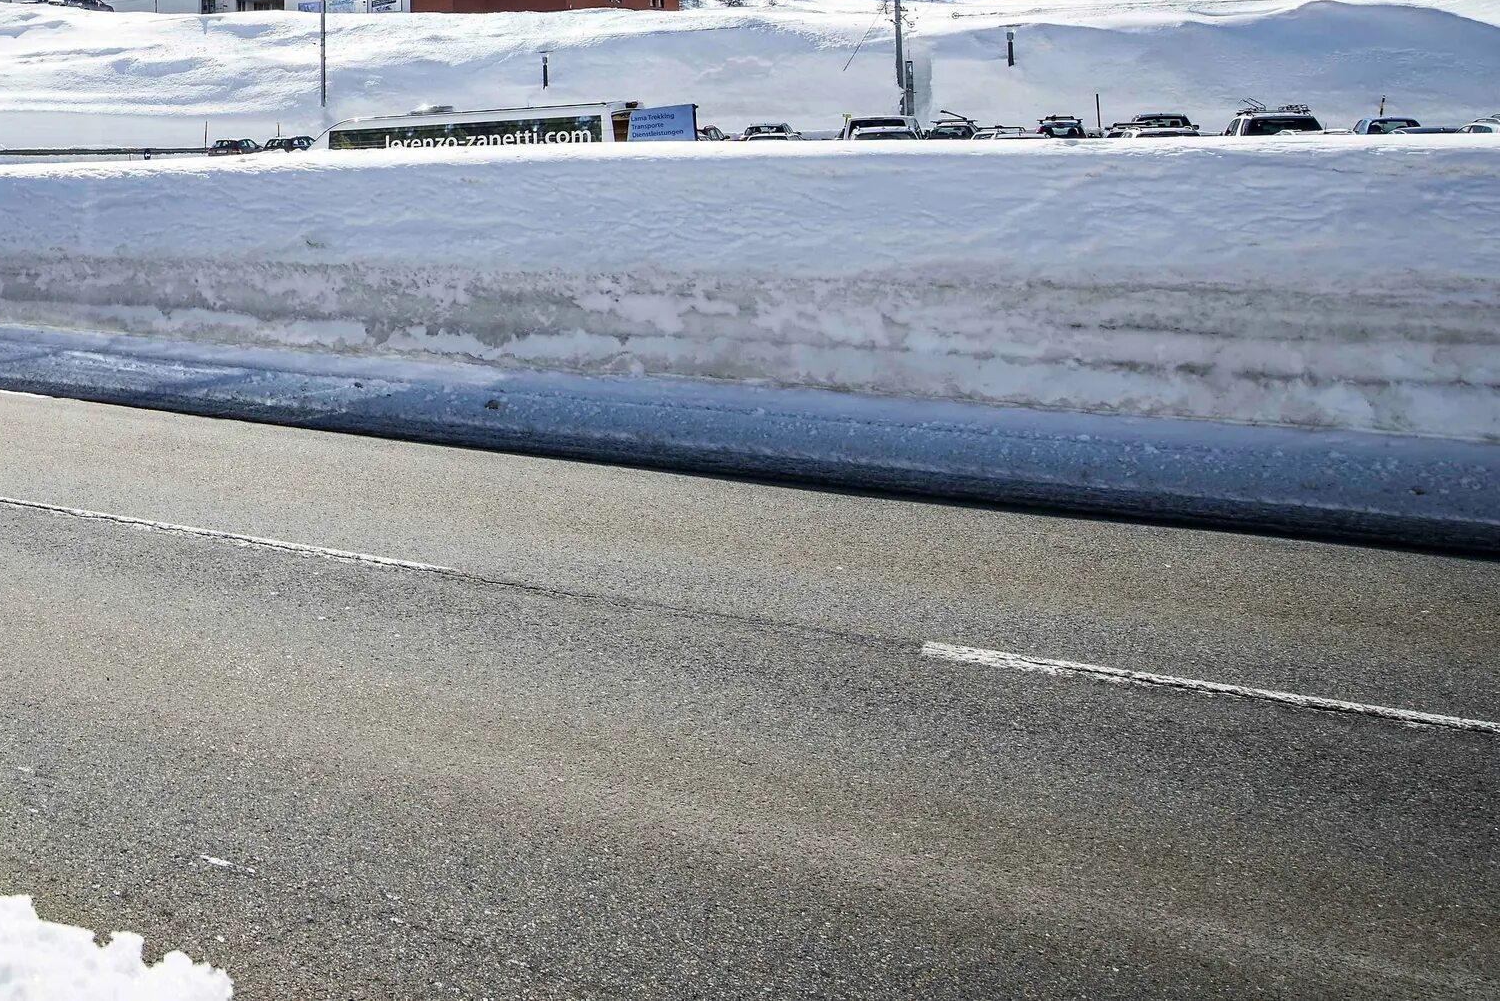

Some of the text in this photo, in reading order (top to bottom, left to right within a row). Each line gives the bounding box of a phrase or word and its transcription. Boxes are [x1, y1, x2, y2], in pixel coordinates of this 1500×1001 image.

[648, 113, 675, 121] Trekking
[632, 122, 664, 130] Transporte
[632, 129, 684, 138] Dienstleistungen
